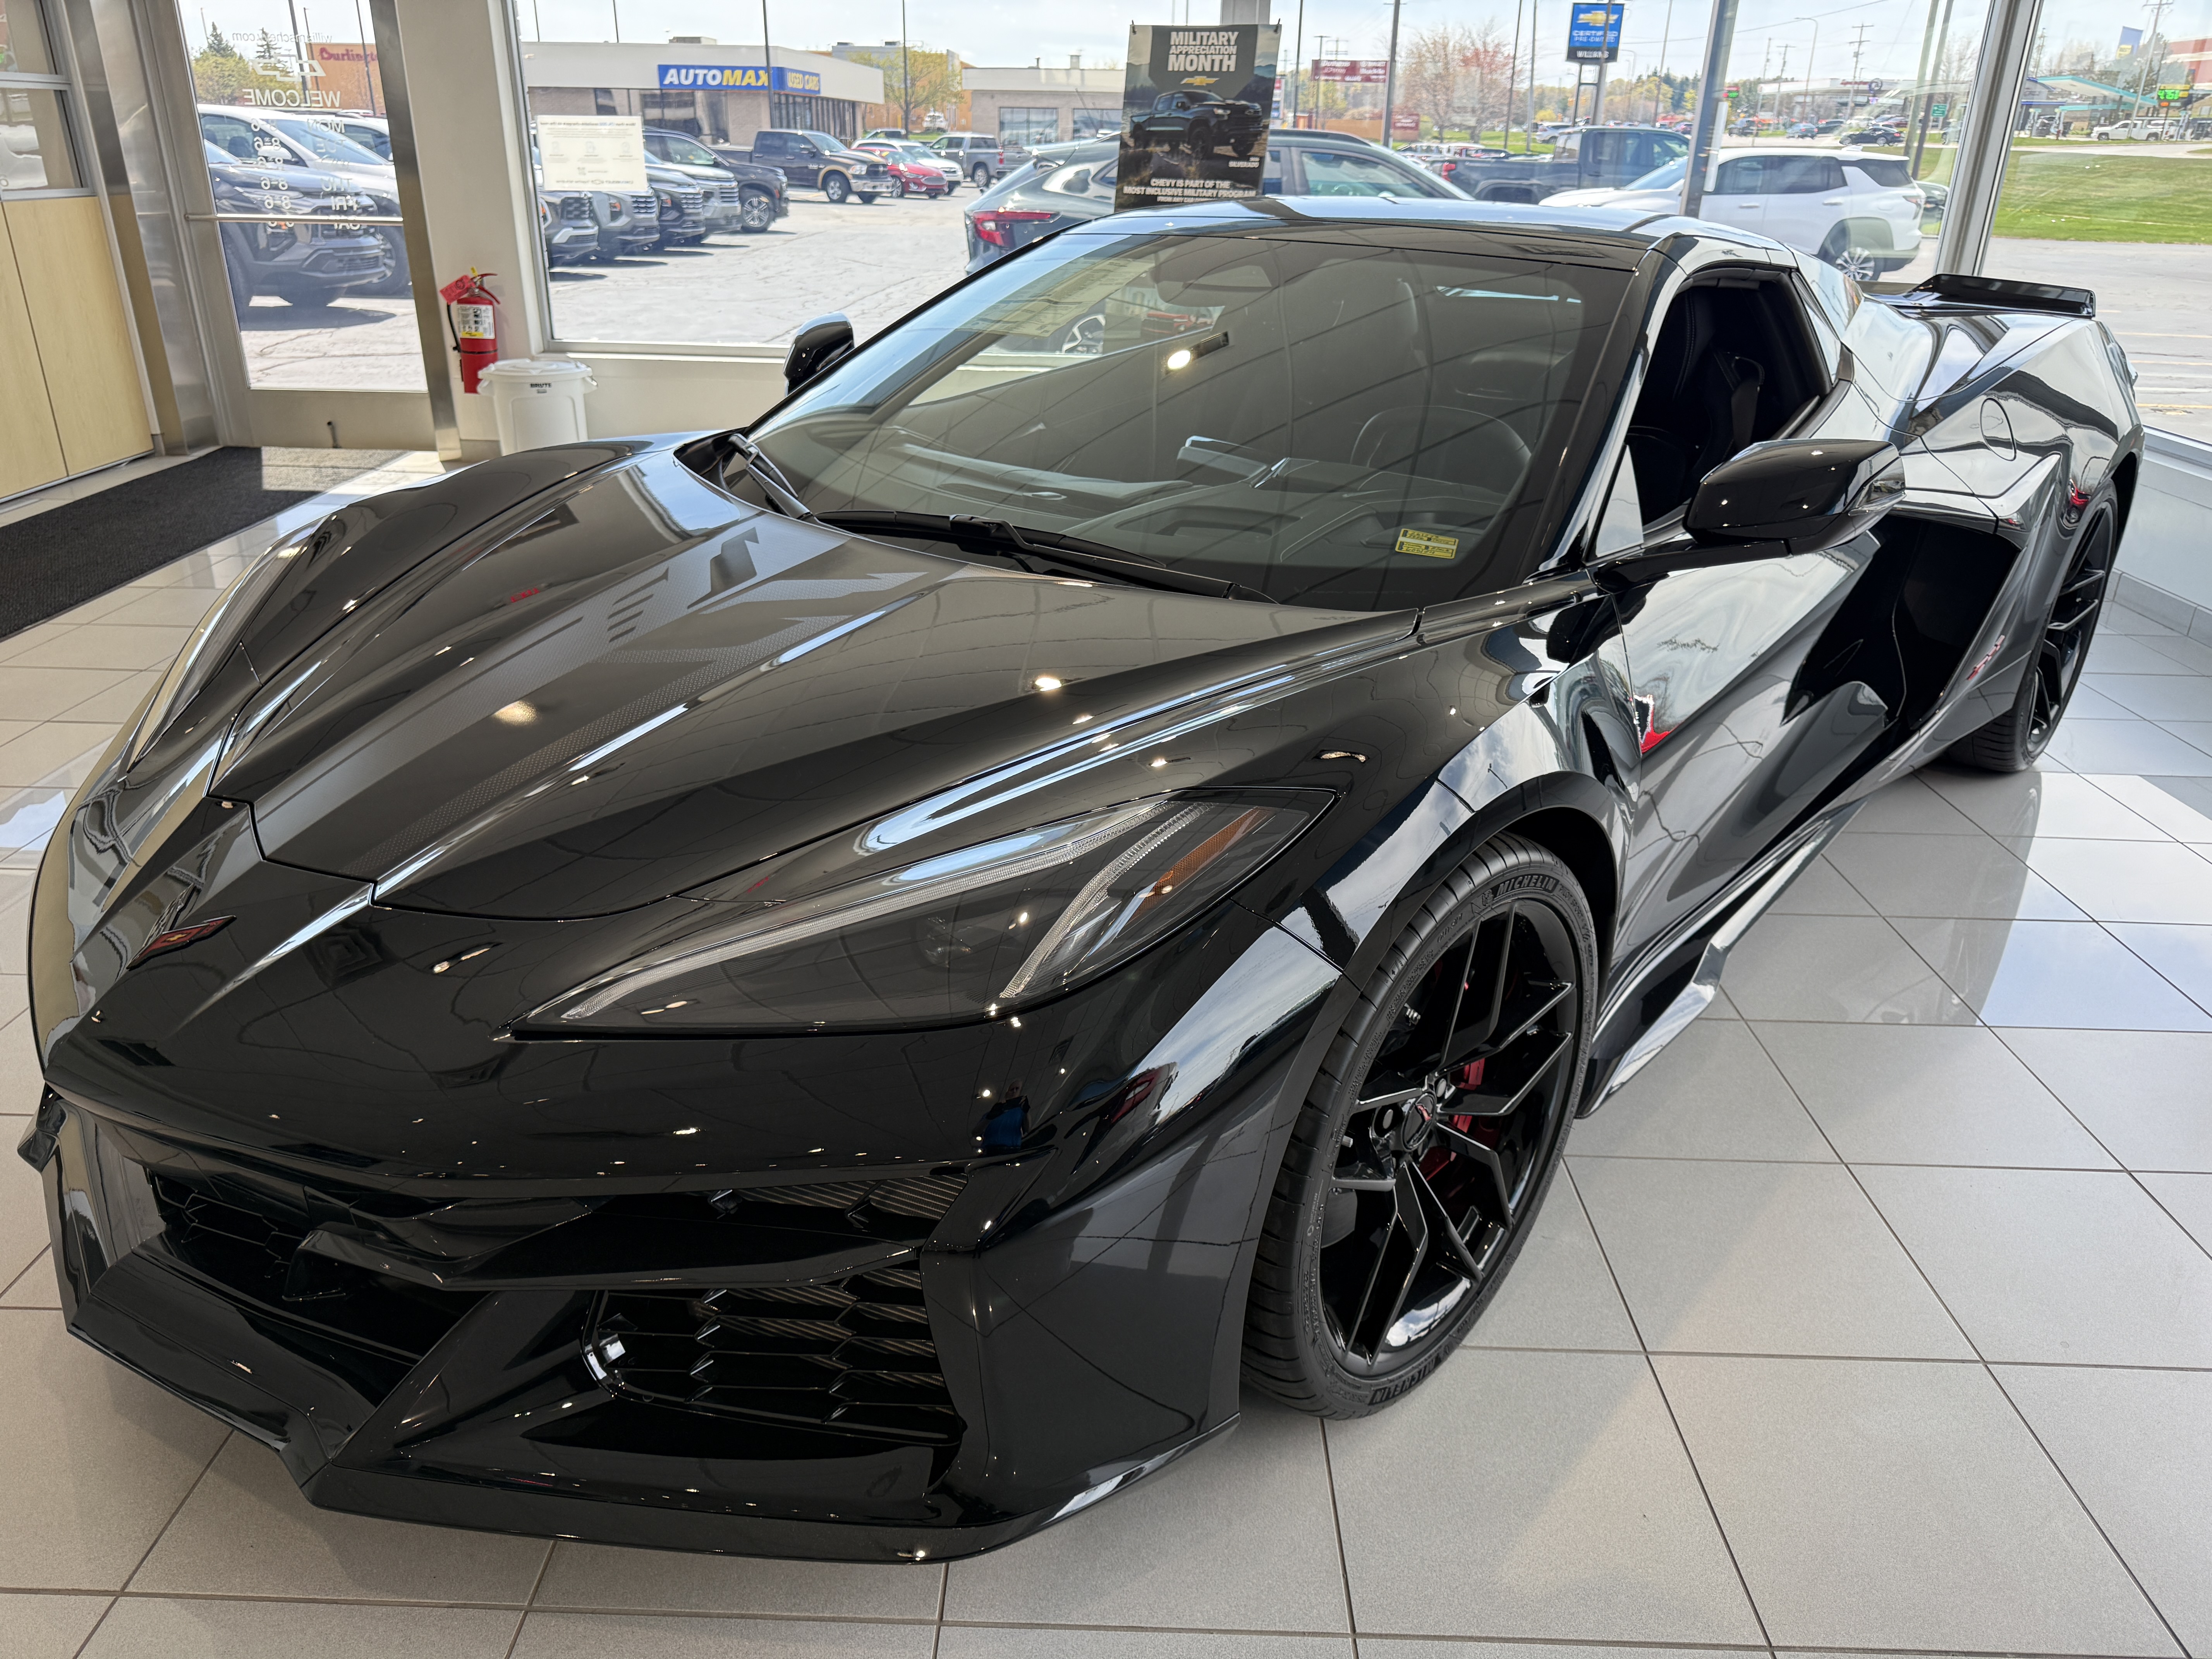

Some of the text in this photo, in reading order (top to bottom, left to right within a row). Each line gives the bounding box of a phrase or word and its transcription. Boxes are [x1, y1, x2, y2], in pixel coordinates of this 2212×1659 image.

[1170, 32, 1239, 45] MILITARY
[1169, 45, 1237, 54] APPRECIATION
[1167, 54, 1237, 72] MONTH
[663, 69, 769, 86] AUTOMAX
[788, 71, 820, 91] USED CARS
[1123, 186, 1146, 194] MOST
[1145, 187, 1183, 196] INCLUSIVE
[1183, 188, 1218, 198] MILITARY
[1151, 178, 1176, 187] CHEVY
[1185, 179, 1204, 188] PART
[1204, 180, 1216, 188] OF
[1216, 180, 1231, 189] THE
[1496, 875, 1556, 896] MICHELIN
[1559, 886, 1583, 919] PILOT SPORT
